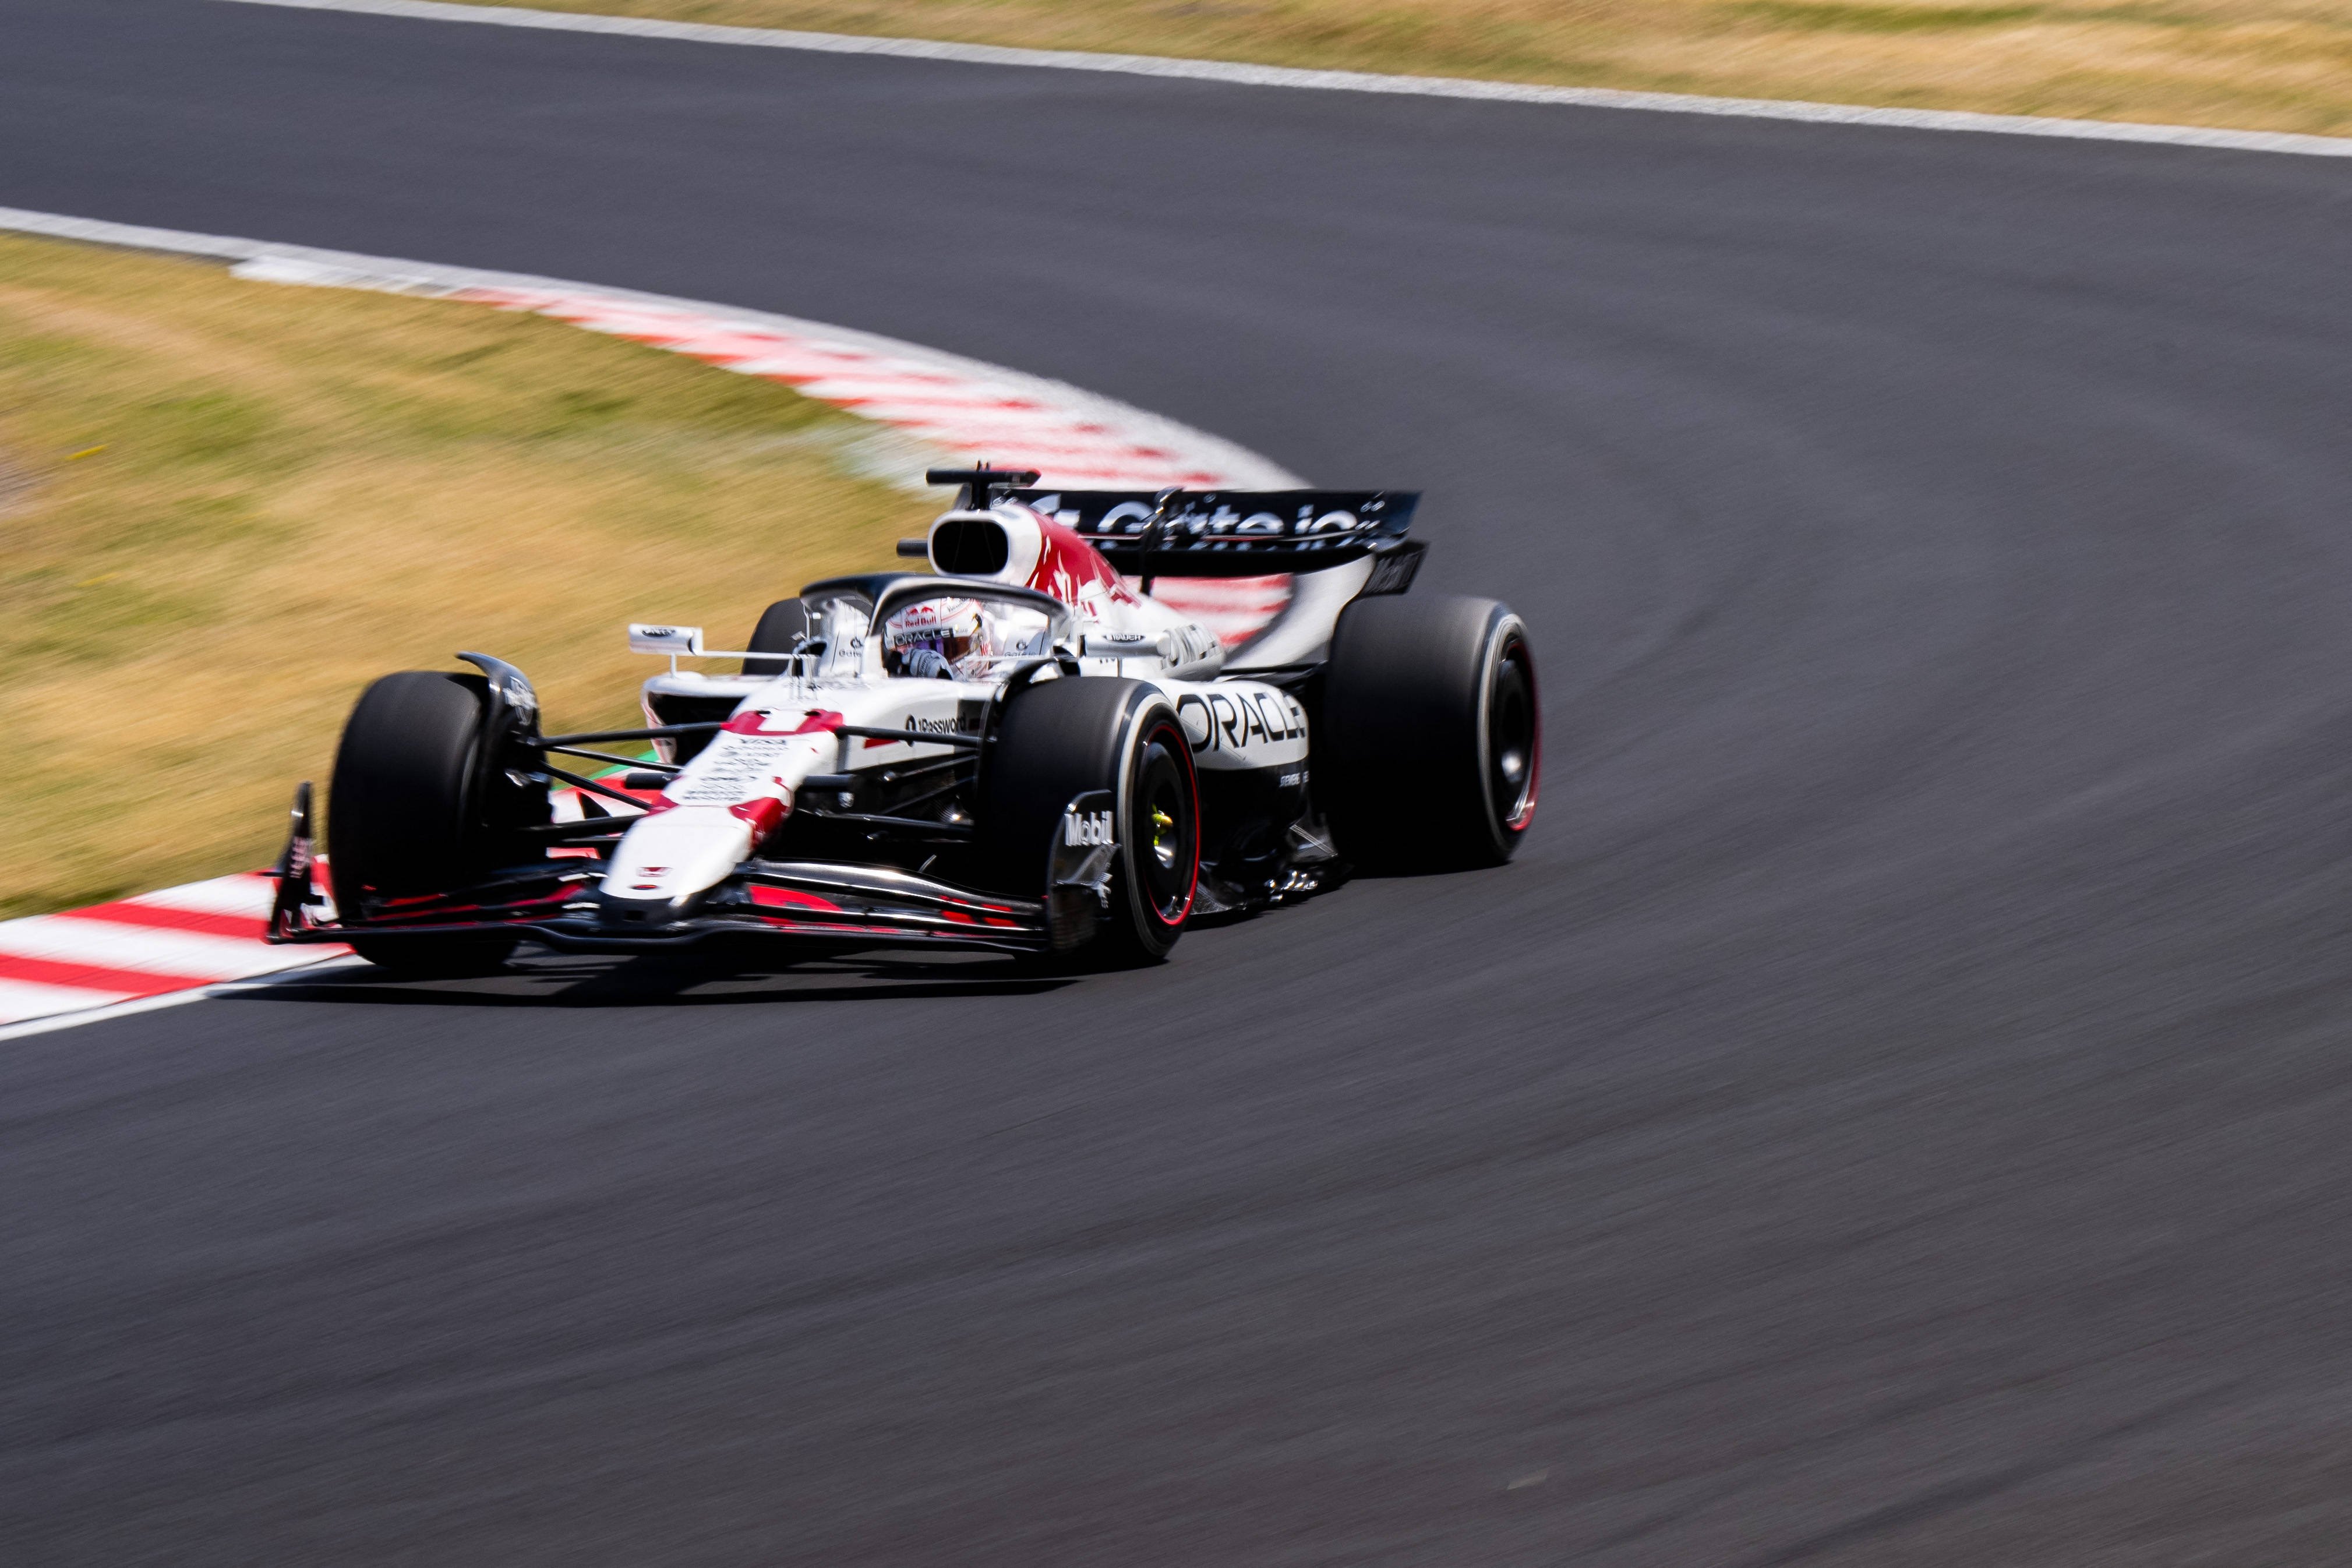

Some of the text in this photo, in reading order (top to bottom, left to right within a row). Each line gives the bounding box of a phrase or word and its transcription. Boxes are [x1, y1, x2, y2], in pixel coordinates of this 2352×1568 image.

[905, 616, 937, 628] Red Bull
[894, 628, 951, 646] ORACLE
[918, 712, 967, 734] 1Password
[1176, 693, 1305, 753] ORACLE
[1064, 811, 1113, 846] Mobil
